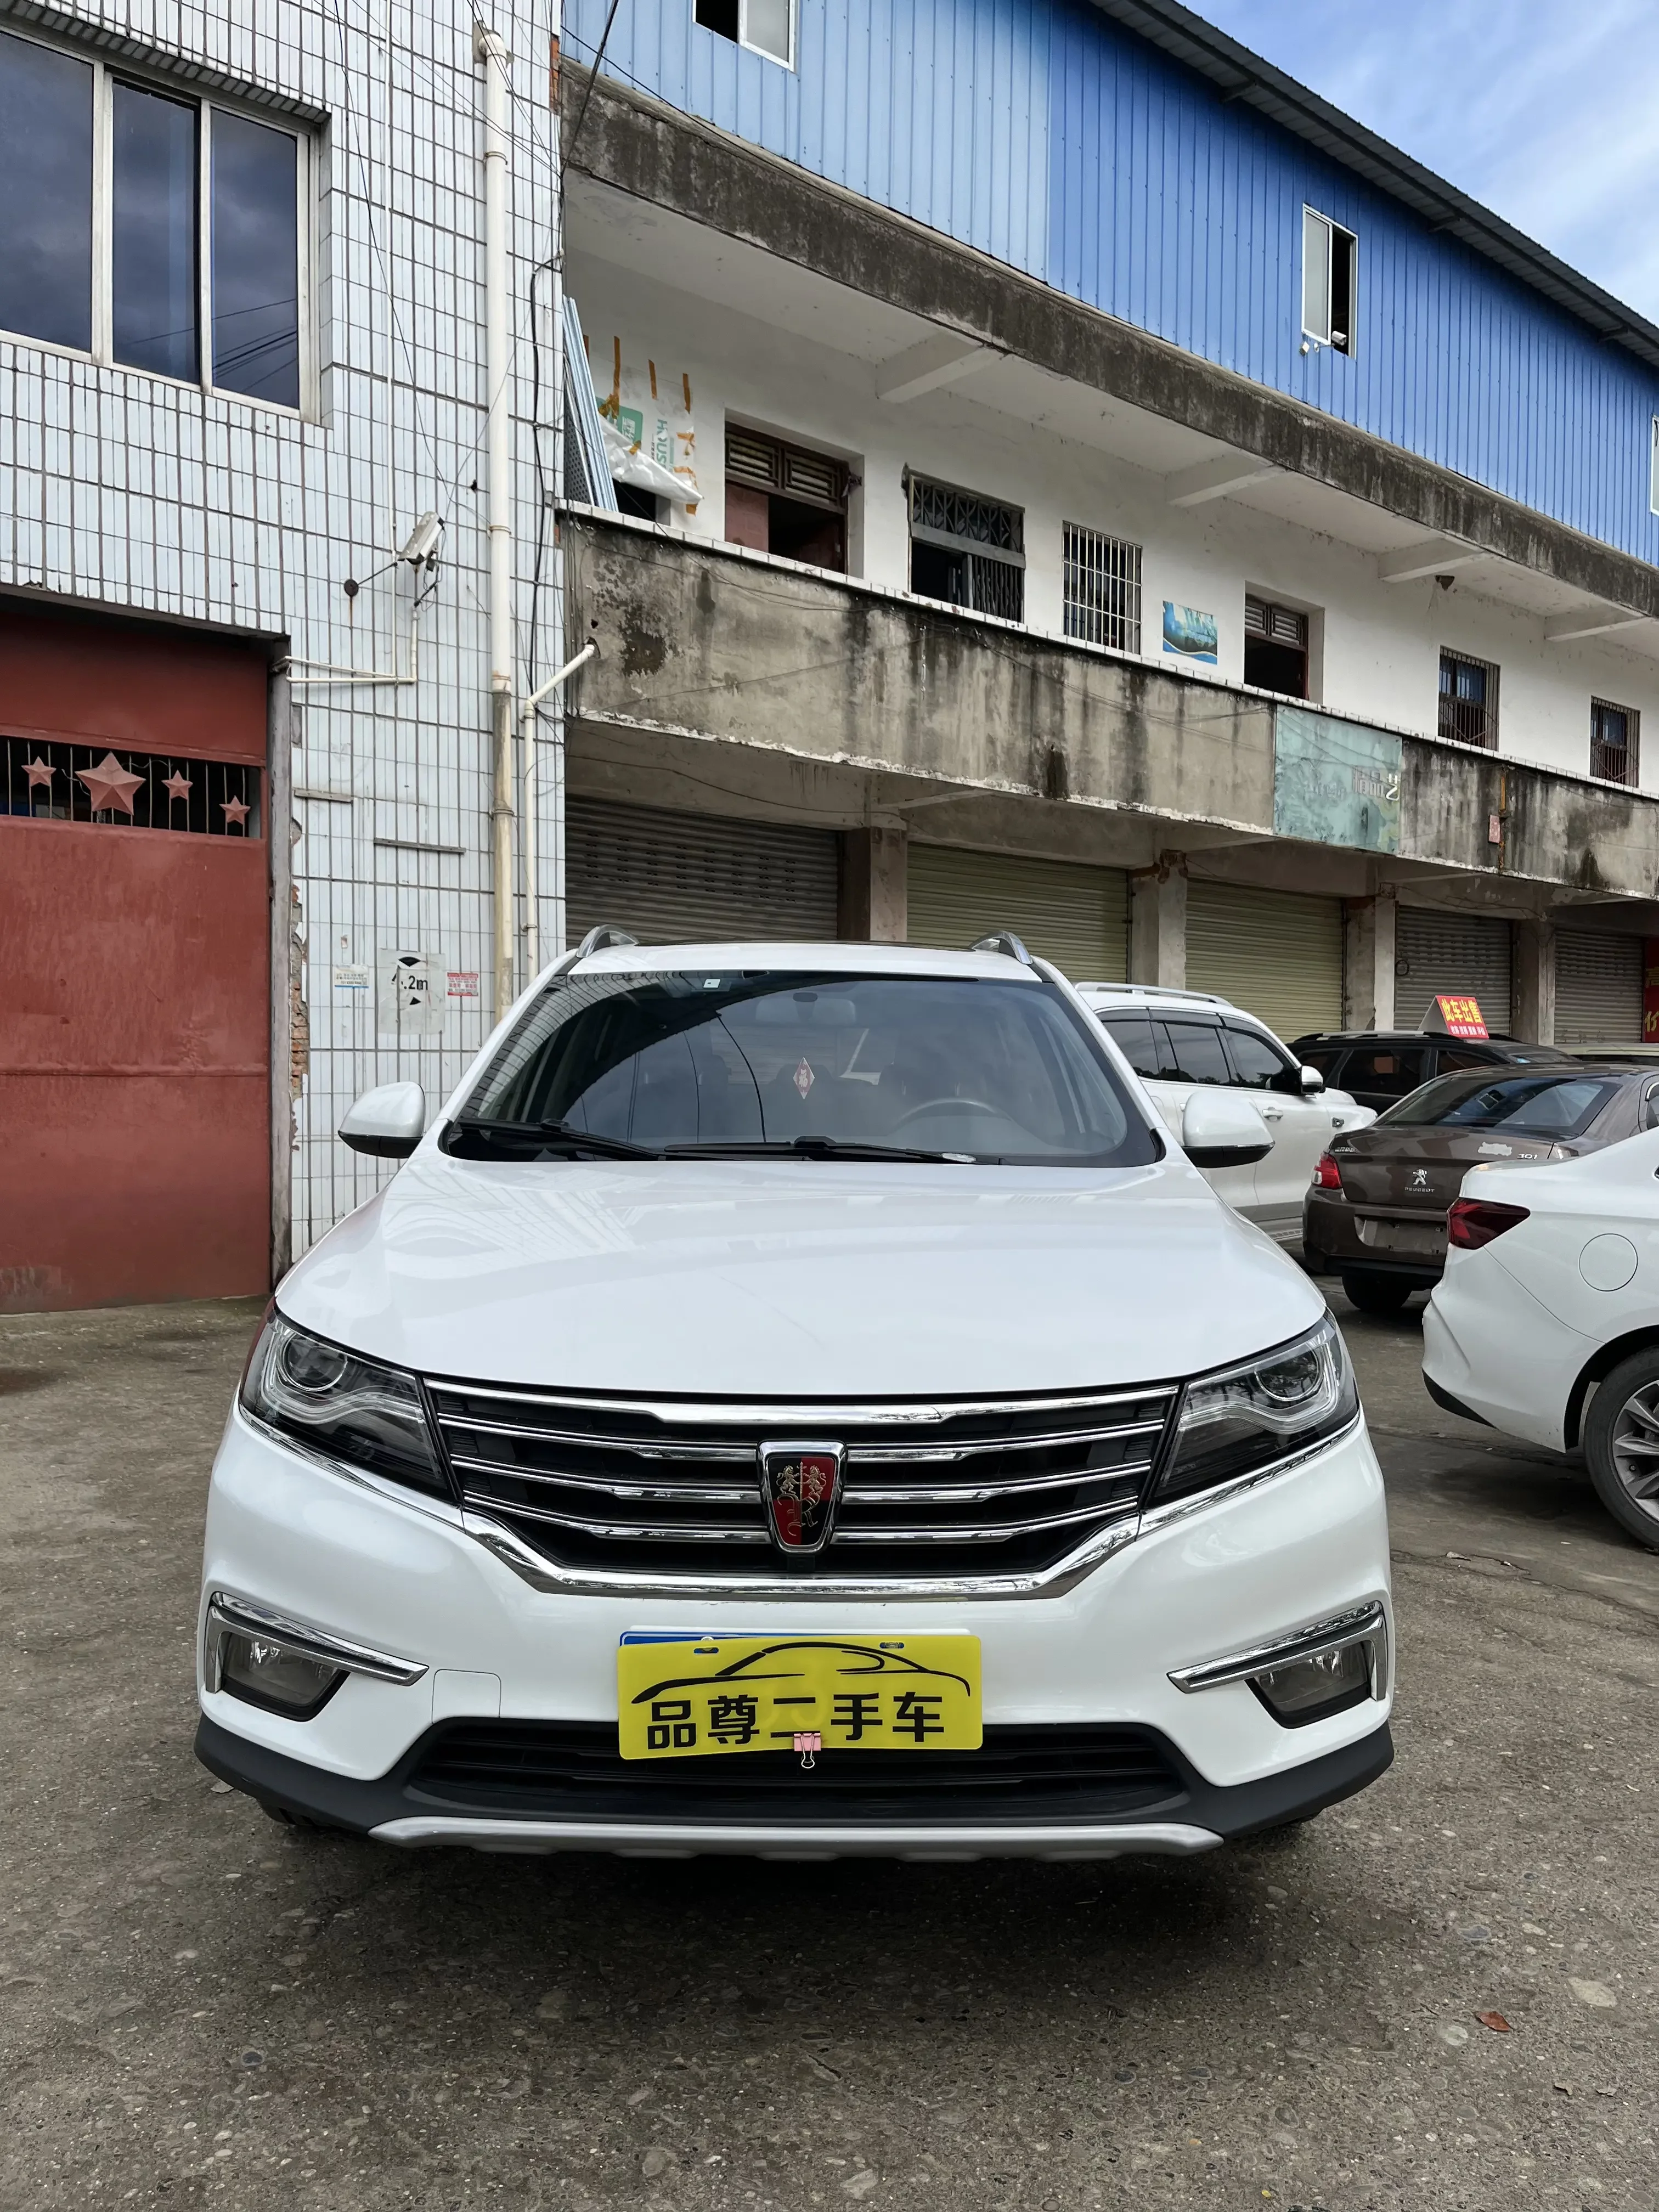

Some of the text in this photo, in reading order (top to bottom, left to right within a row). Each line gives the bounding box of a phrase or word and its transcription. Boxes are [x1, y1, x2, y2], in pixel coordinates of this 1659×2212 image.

[1441, 998, 1482, 1024] 此车出售
[647, 1691, 945, 1750] 品尊二手车
